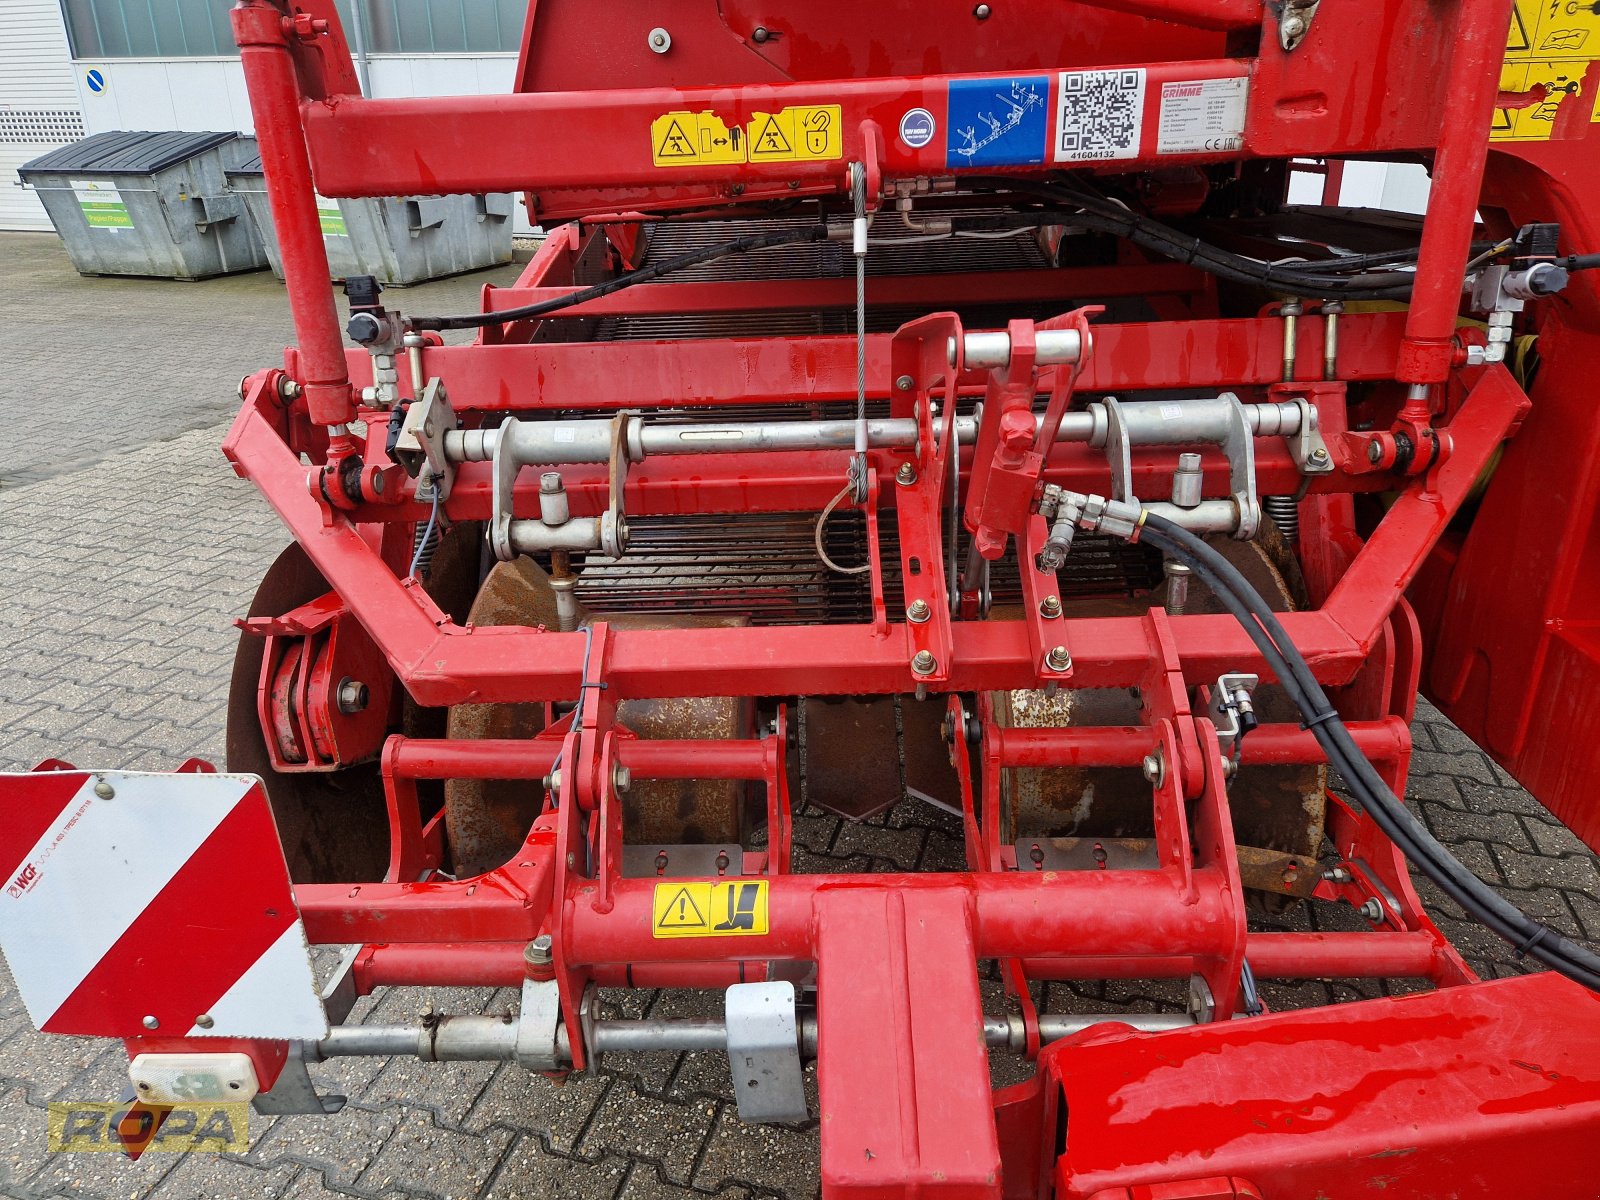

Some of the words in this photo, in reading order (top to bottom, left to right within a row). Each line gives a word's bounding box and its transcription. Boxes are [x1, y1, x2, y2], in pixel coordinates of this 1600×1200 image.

[1163, 87, 1202, 98] GRIMME
[1071, 151, 1115, 159] 41604132
[14, 863, 37, 889] WGF
